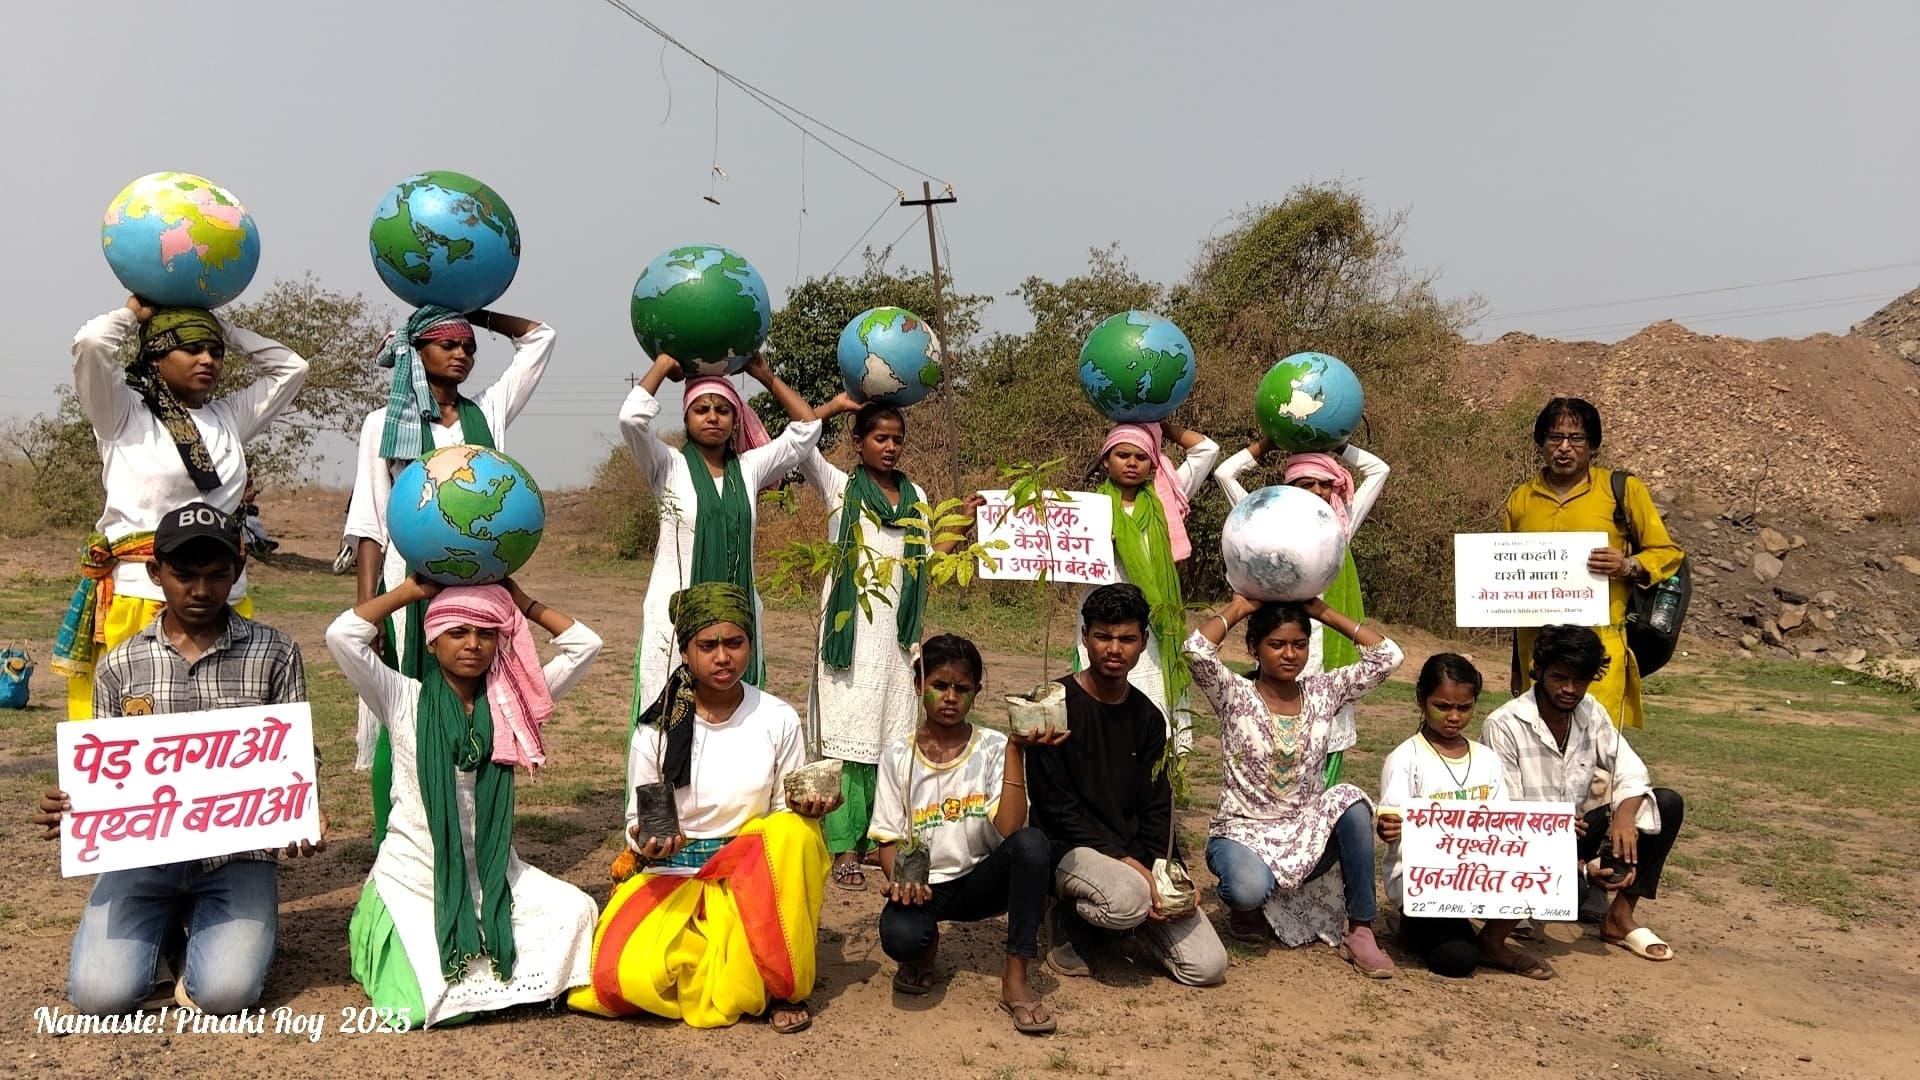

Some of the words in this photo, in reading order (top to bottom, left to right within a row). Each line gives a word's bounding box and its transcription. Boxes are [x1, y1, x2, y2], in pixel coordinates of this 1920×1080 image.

[179, 508, 227, 529] BOY
[1014, 526, 1050, 554] कैरी
[1056, 528, 1094, 555] बैग
[1493, 551, 1518, 561] क्या
[1521, 548, 1557, 561] कहती
[1495, 569, 1526, 581] धरती
[1529, 571, 1558, 580] माता
[1479, 588, 1499, 600] मेरा
[1503, 590, 1524, 600] रूप
[1528, 590, 1548, 600] मत
[1552, 587, 1594, 601] बिगाड़ो
[73, 733, 139, 789] पेड़
[71, 785, 183, 862] पृथ्वी
[1407, 802, 1466, 832] झरिया
[1527, 812, 1574, 836] खदान
[1436, 833, 1455, 854] में
[1456, 834, 1501, 860] पृथ्वी
[1500, 836, 1530, 857] को
[1438, 903, 1466, 913] APRIL
[1541, 908, 1571, 917] JHARIA
